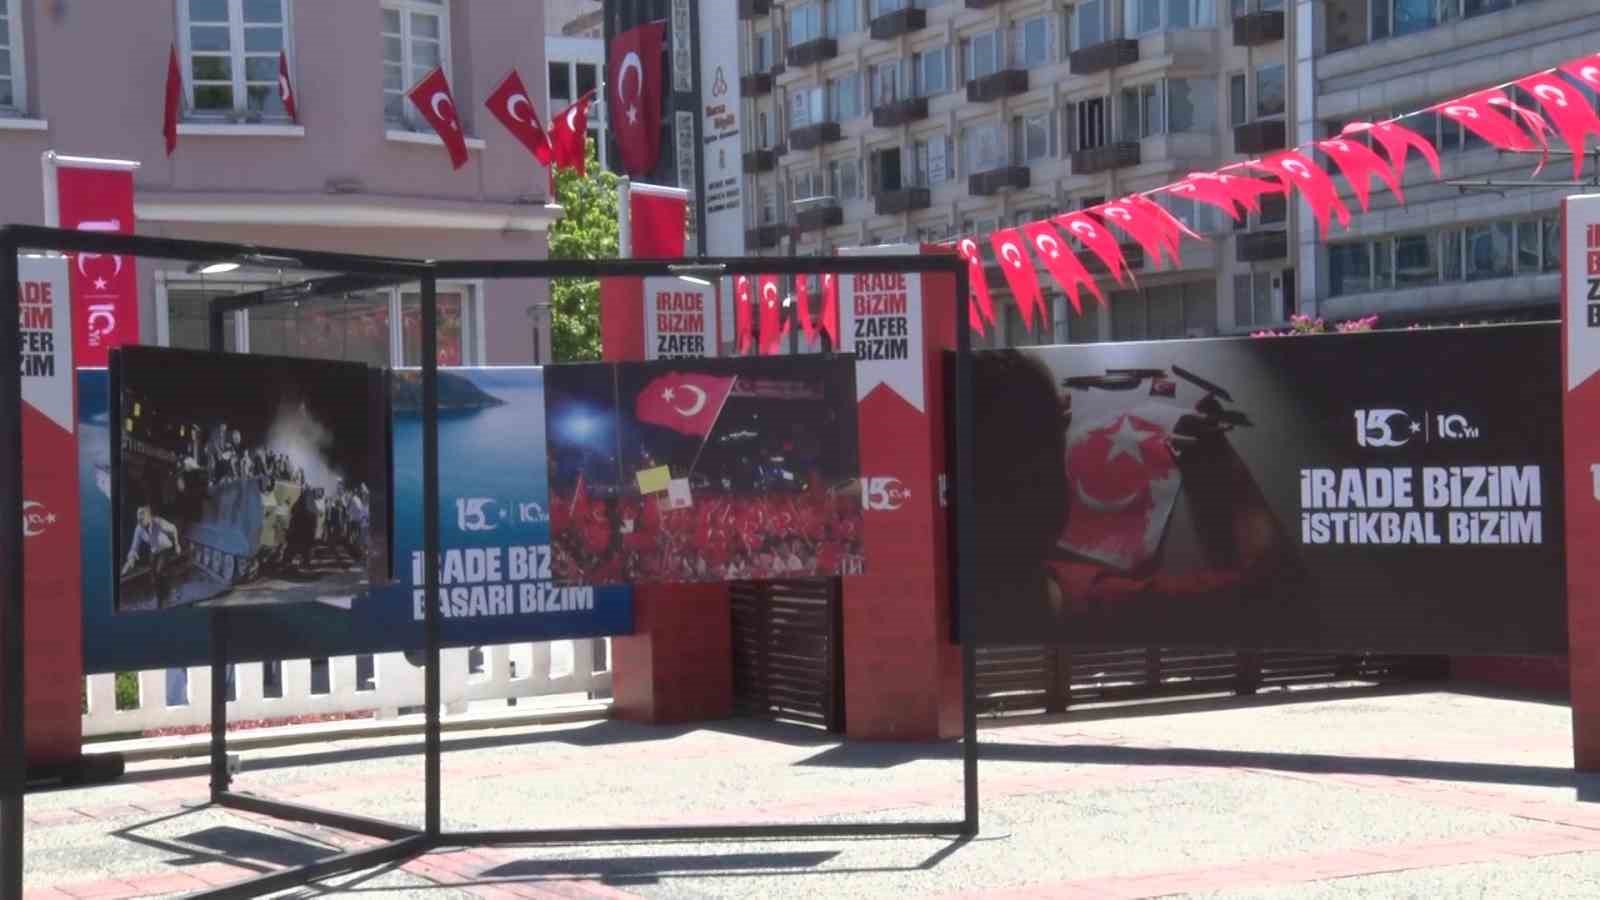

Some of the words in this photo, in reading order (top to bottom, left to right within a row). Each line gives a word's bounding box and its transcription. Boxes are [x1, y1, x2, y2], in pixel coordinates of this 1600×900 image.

[18, 281, 52, 303] ADE
[854, 272, 906, 292] İRADE
[656, 292, 704, 311] İRADE
[855, 293, 907, 315] BİZİM
[657, 313, 704, 333] BİZİM
[855, 316, 908, 337] ZAFER
[18, 332, 54, 351] FER
[657, 335, 705, 353] ZAFER
[856, 338, 908, 360] BİZİM
[1300, 467, 1414, 509] İRADE
[1422, 465, 1542, 508] BİZİM
[1301, 511, 1442, 545] İSTİKBAL
[1448, 510, 1543, 545] BİZİM
[411, 547, 502, 585] İADE
[508, 545, 552, 581] BİZ
